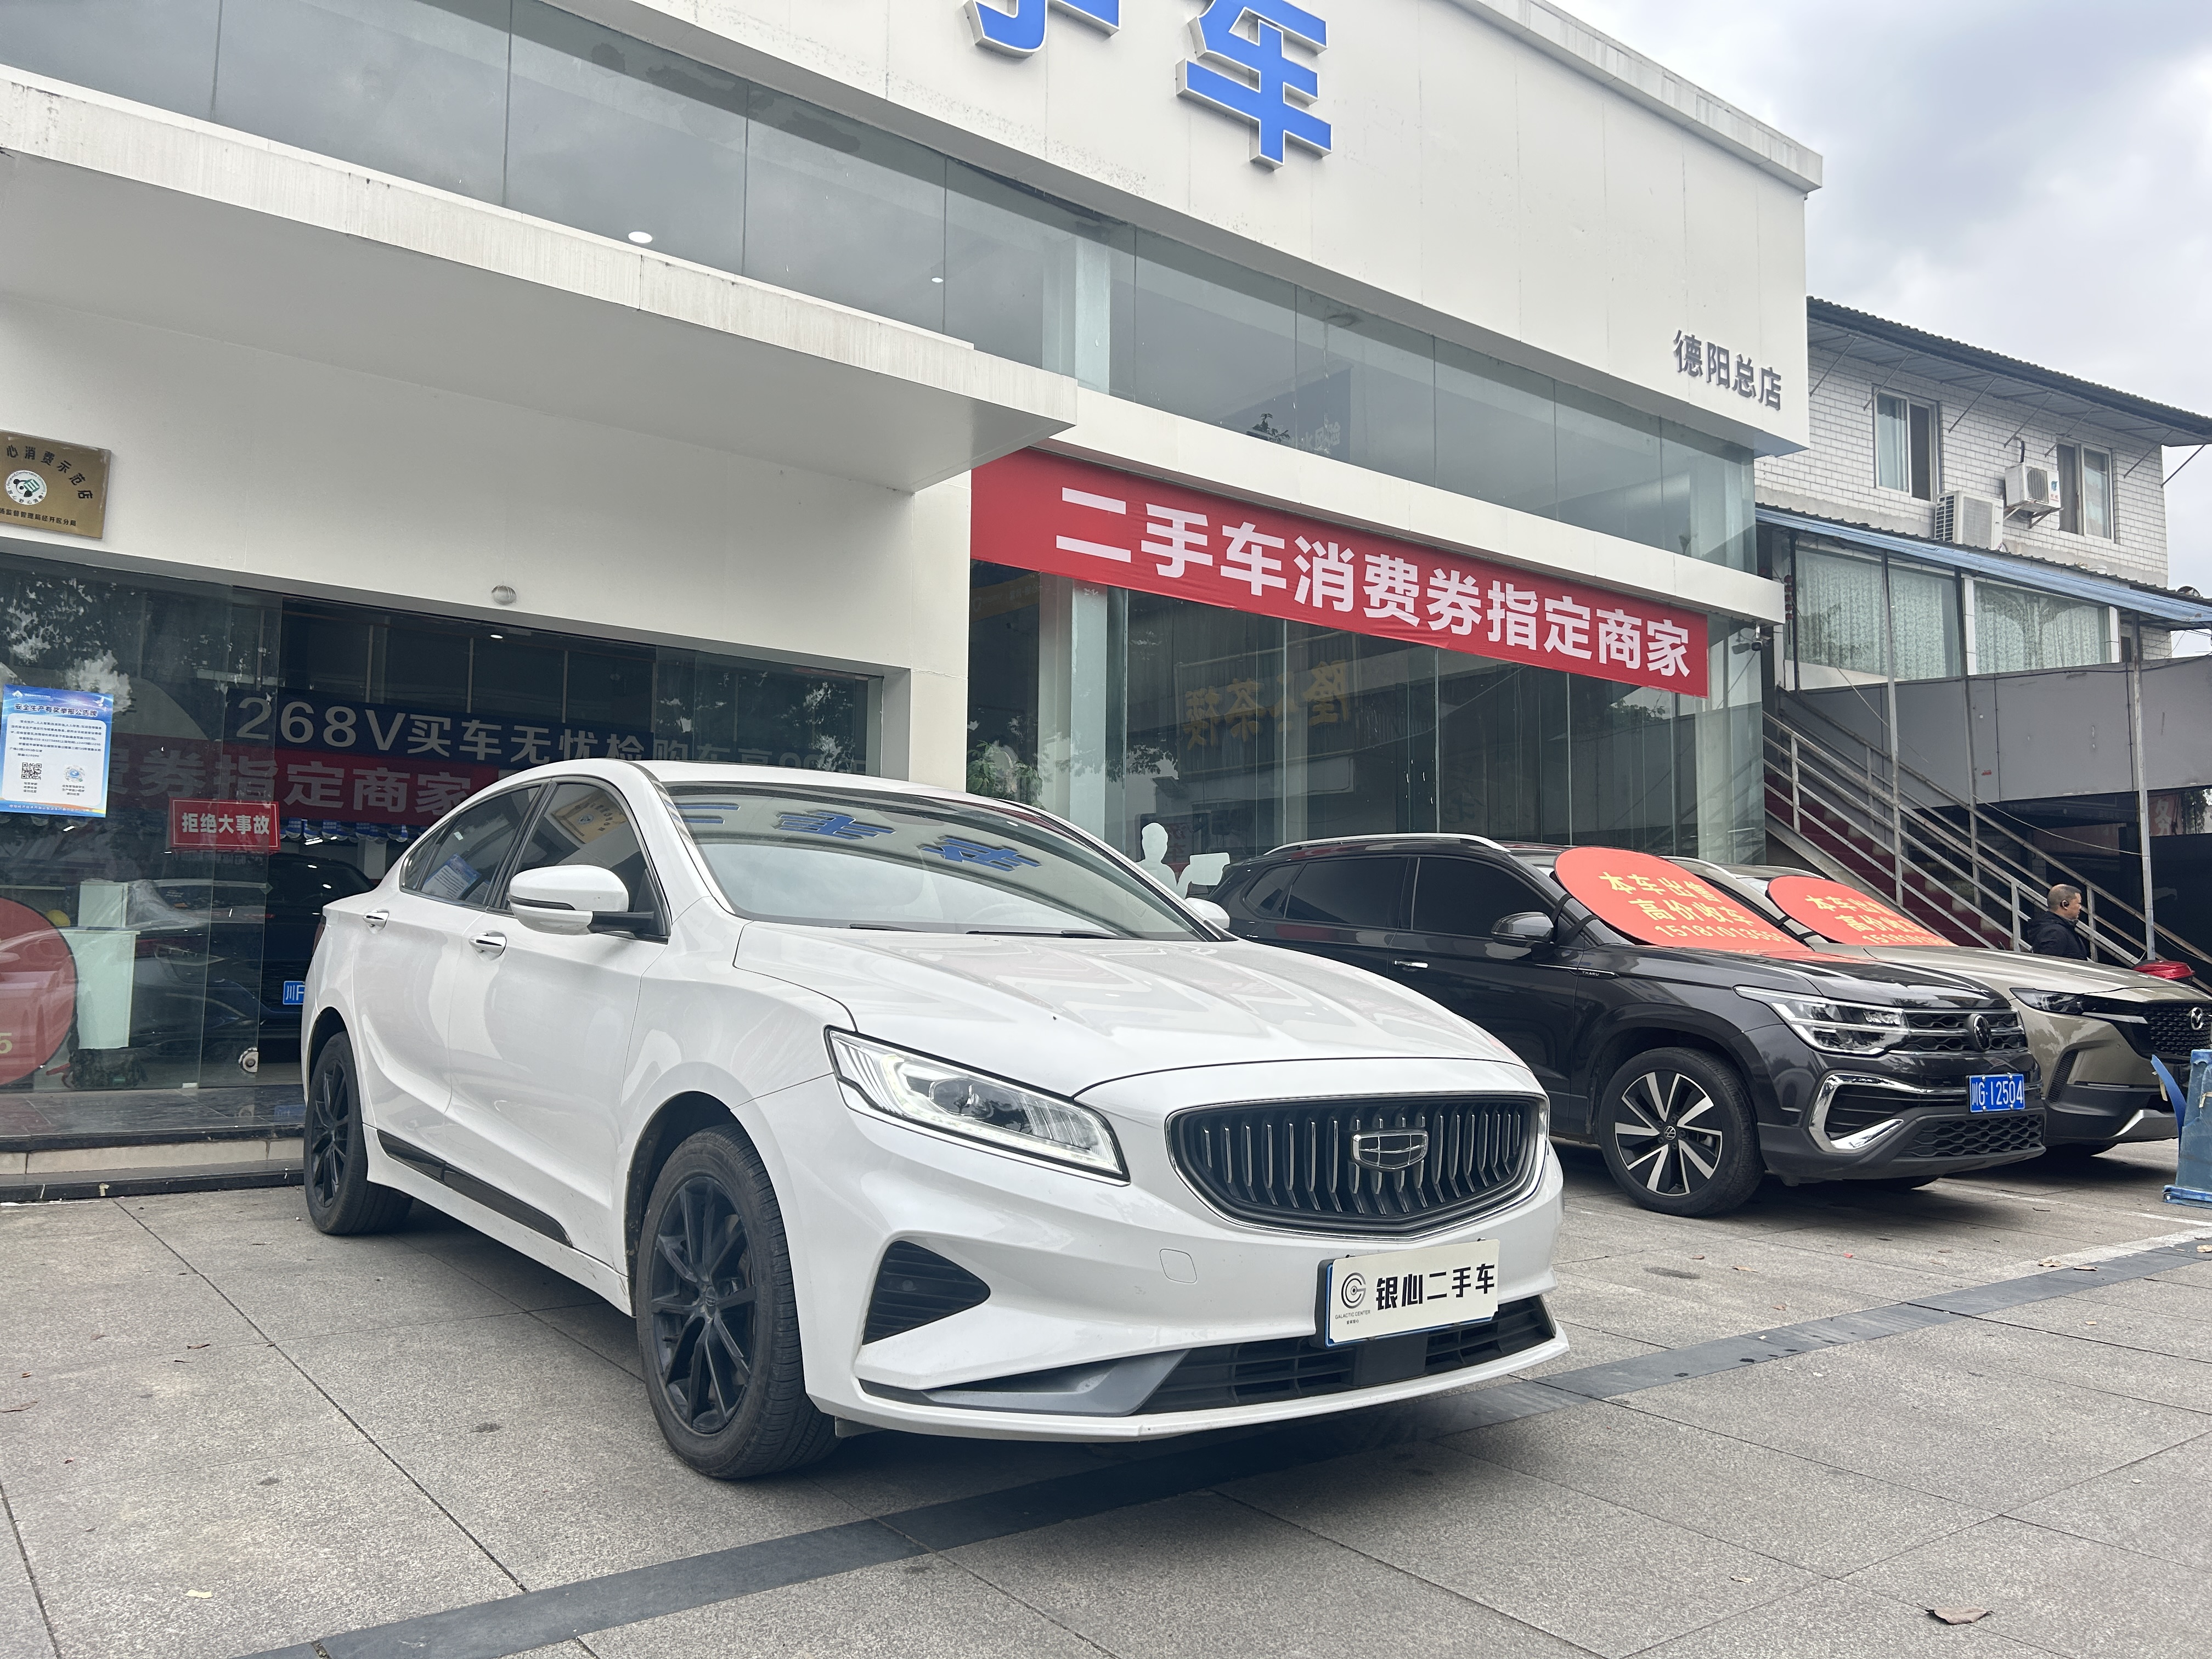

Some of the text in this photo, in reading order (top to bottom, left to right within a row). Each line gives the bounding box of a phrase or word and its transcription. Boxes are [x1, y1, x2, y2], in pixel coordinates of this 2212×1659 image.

[1673, 329, 1782, 411] 德阳总店
[7, 444, 93, 499] 心消费示范店
[1056, 486, 1691, 678] 二手车消费券指定商家
[182, 812, 270, 835] 拒绝大事故
[1598, 871, 1722, 904] 本车出售
[1628, 898, 1755, 927] 高价收车
[1375, 1263, 1495, 1311] 银心二手车
